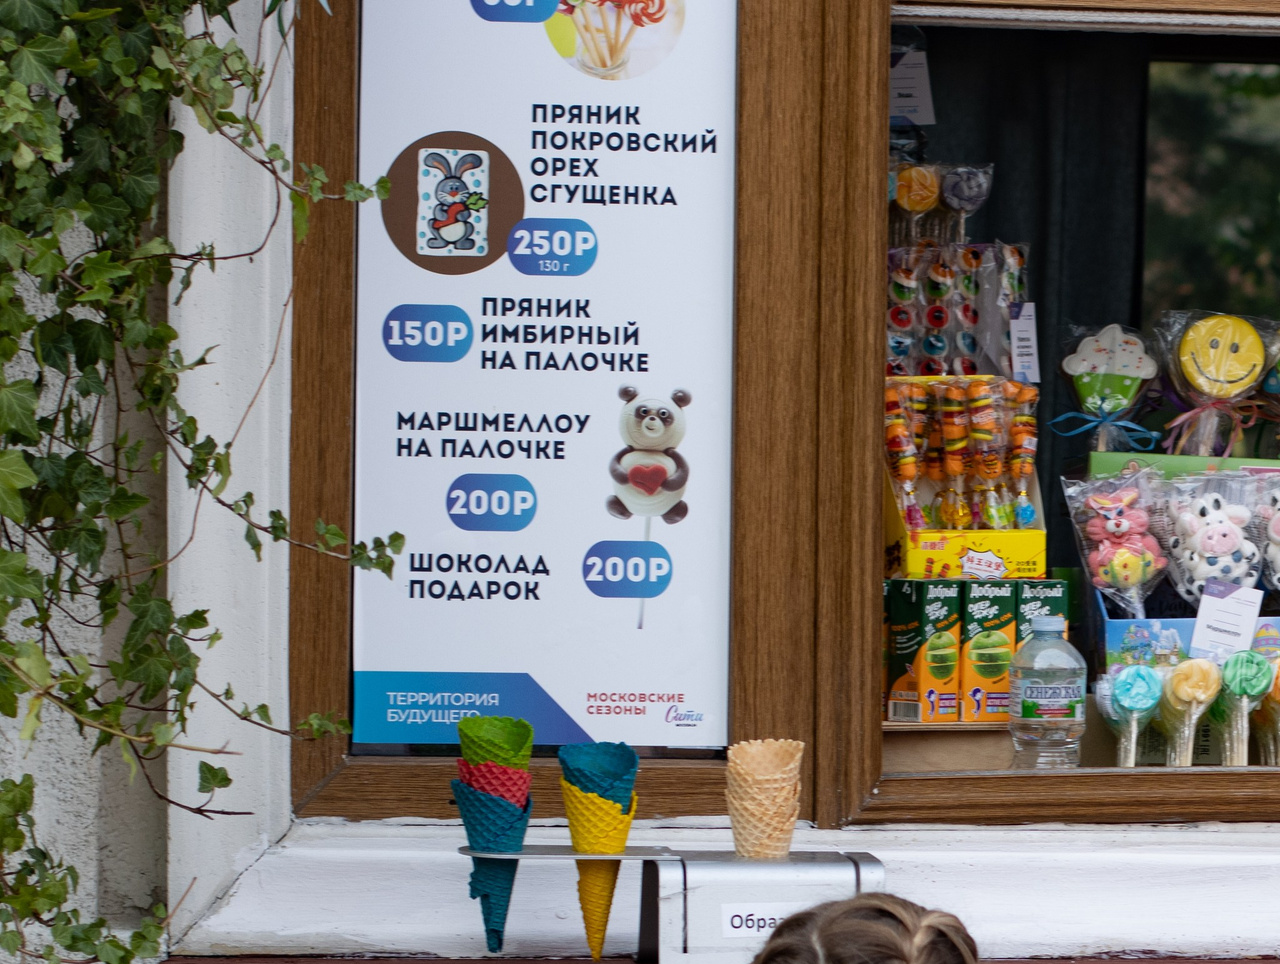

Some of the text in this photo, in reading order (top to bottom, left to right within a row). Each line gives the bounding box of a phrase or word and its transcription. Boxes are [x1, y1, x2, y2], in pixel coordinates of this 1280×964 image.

[531, 104, 641, 125] ПРЯНИК
[531, 129, 717, 154] ПОКРОВСКИЙ
[531, 157, 599, 177] ОРЕХ
[530, 184, 678, 206] СГУЩЕНКА
[513, 230, 596, 256] 250Р
[538, 260, 561, 272] 130
[481, 297, 591, 318] ПРЯНИК
[388, 321, 468, 347] 150Р
[481, 321, 640, 345] ИМБИРНЫЙ
[481, 351, 649, 372] НА ПАЛОЧКЕ
[397, 411, 591, 433] МАРШМЕЛЛОУ
[397, 439, 566, 460] НА ПАЛОЧКЕ
[449, 490, 534, 516] 200Р
[409, 553, 549, 576] ШОКОЛАД
[585, 556, 671, 582] 200Р
[409, 580, 540, 601] ПОДАРОК
[927, 583, 959, 599] Добрый
[970, 583, 1014, 599] Добрый
[1021, 583, 1065, 600] Добрый
[386, 691, 499, 706] ТЕРРИТОРИЯ
[586, 692, 685, 704] МОСКОВСКИЕ
[586, 704, 646, 716] СЕЗОНЫ
